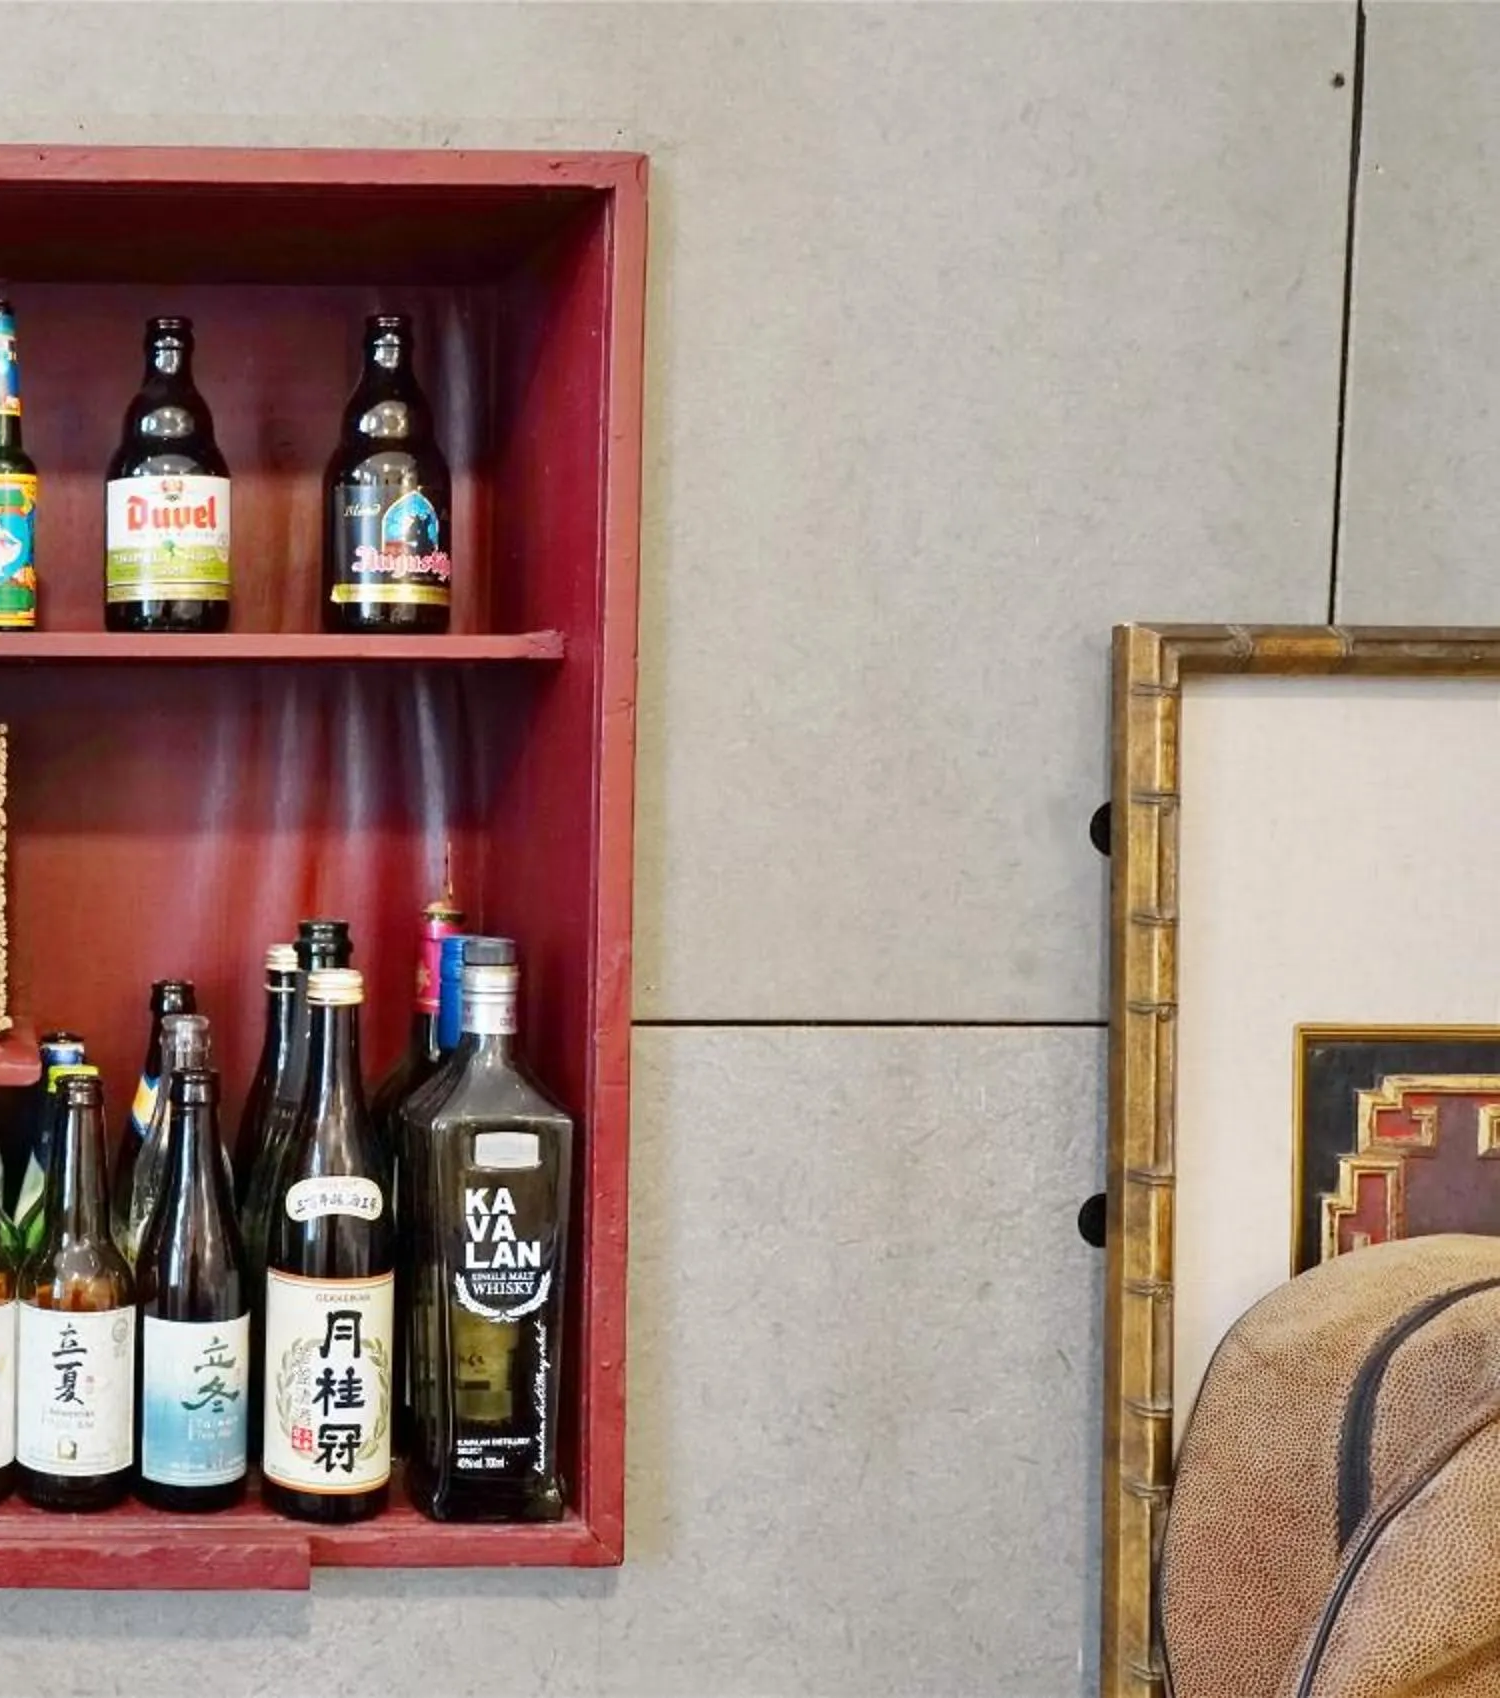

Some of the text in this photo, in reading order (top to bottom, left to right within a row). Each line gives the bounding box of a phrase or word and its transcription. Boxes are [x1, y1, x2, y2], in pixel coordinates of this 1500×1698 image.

[127, 495, 217, 531] Duvel
[465, 1187, 516, 1215] KA
[465, 1215, 516, 1242] VA
[465, 1241, 541, 1269] LAN
[471, 1271, 536, 1281] SINGLE MALT
[471, 1281, 534, 1295] WHISKY
[51, 1320, 88, 1406] 立夏
[180, 1335, 241, 1413] 立冬
[311, 1309, 366, 1474] 月桂冠
